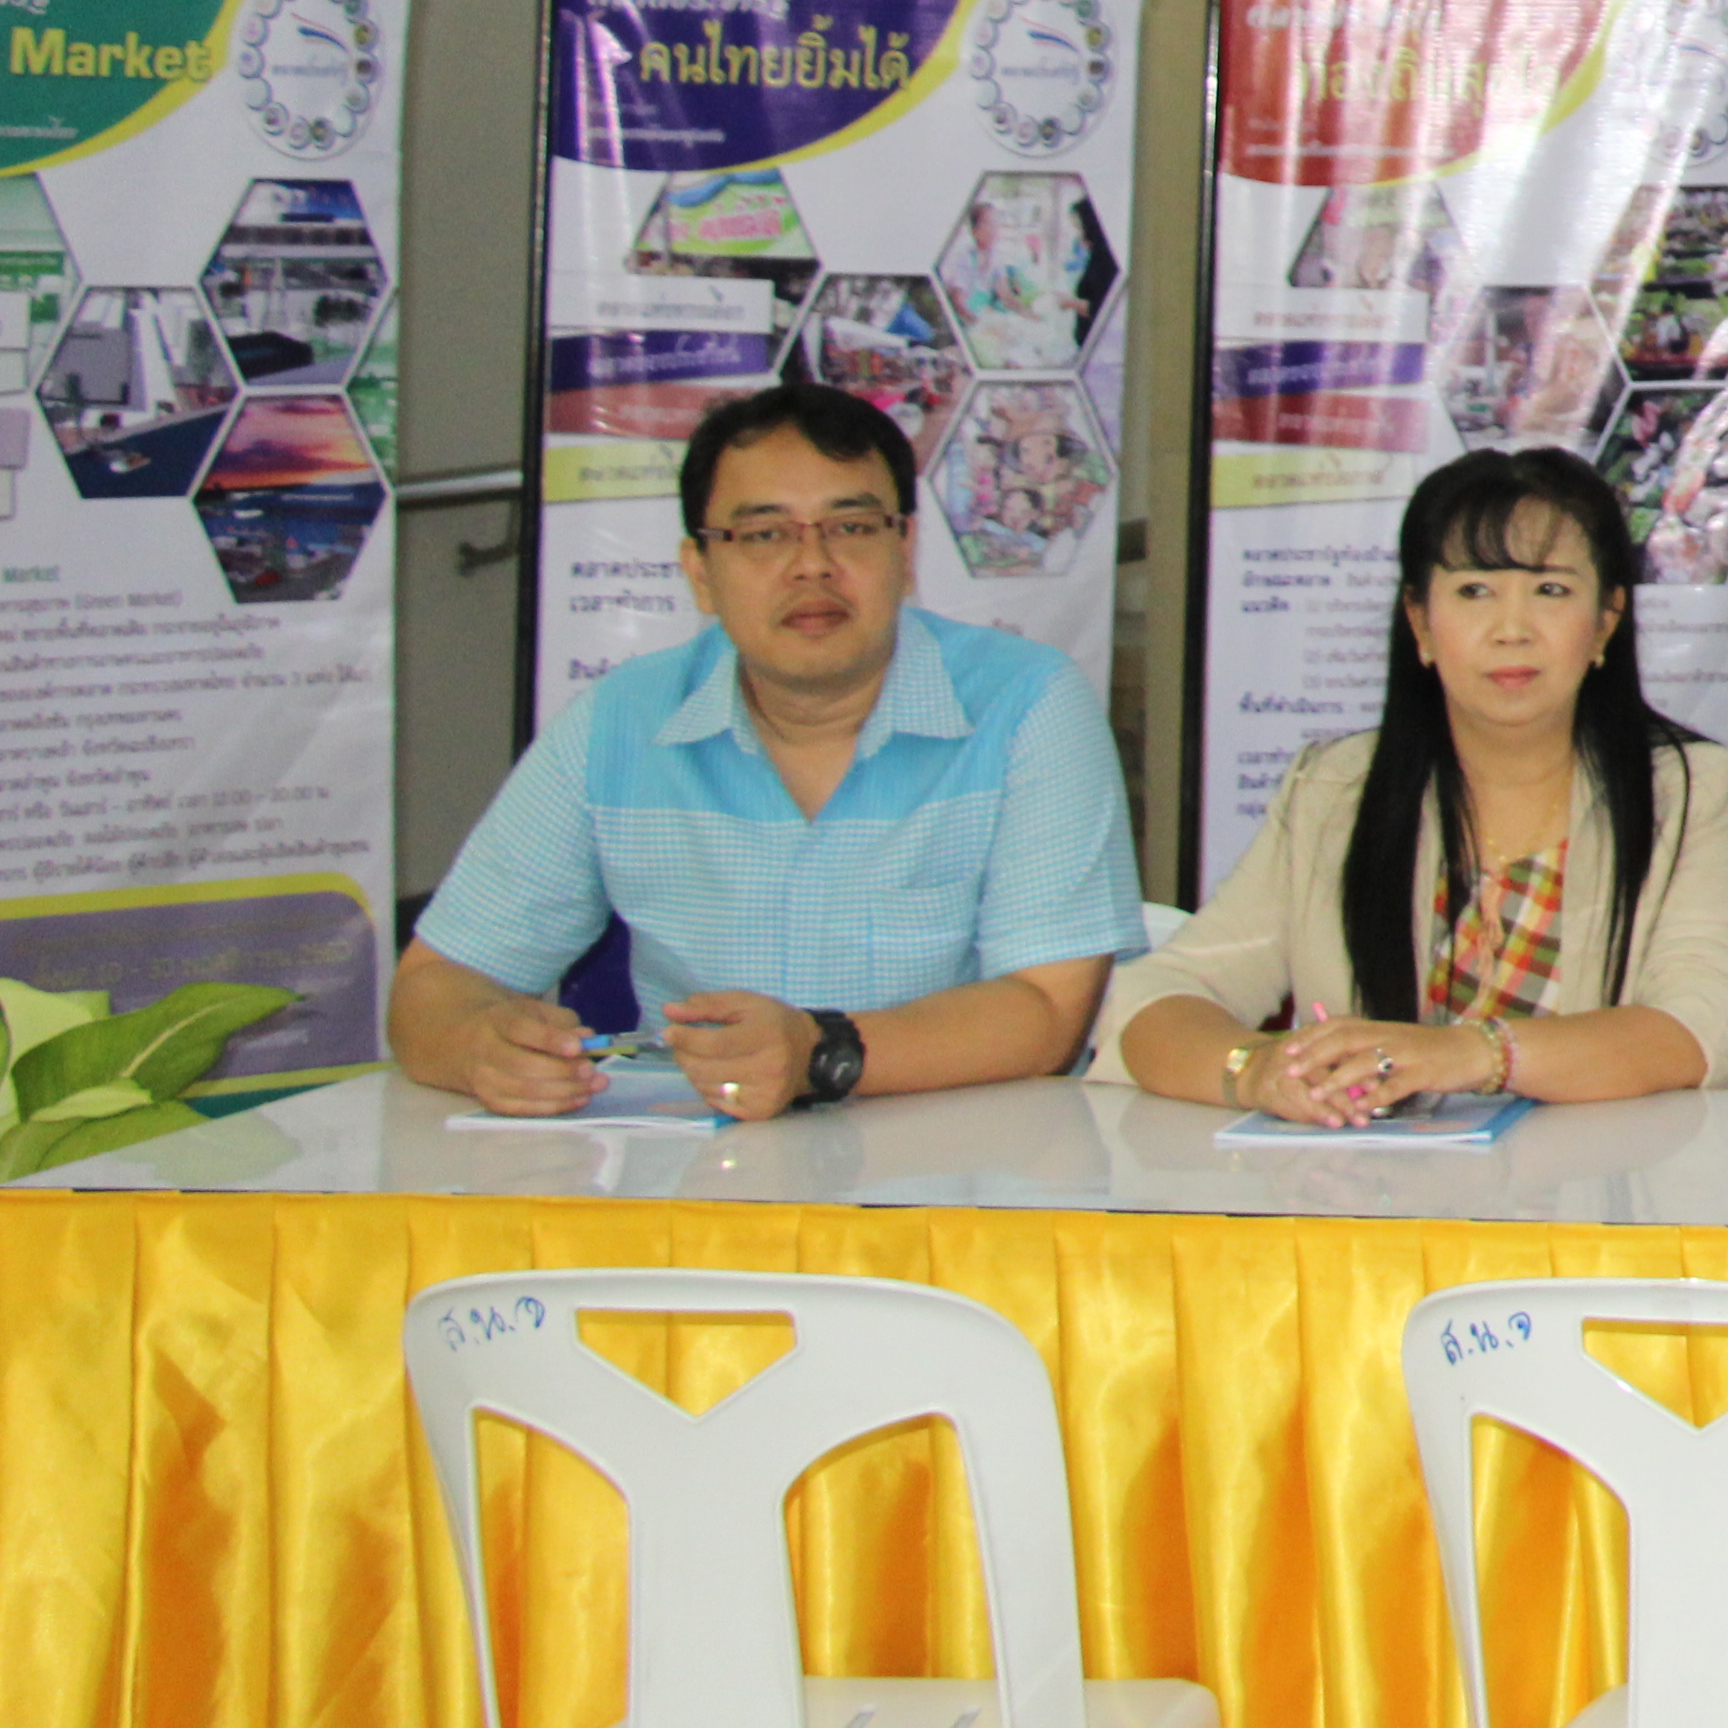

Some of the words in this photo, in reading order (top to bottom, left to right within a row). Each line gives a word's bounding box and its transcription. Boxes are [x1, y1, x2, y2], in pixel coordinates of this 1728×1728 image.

[9, 26, 212, 84] Market
[639, 13, 911, 91] คนไทยยิ้มได้
